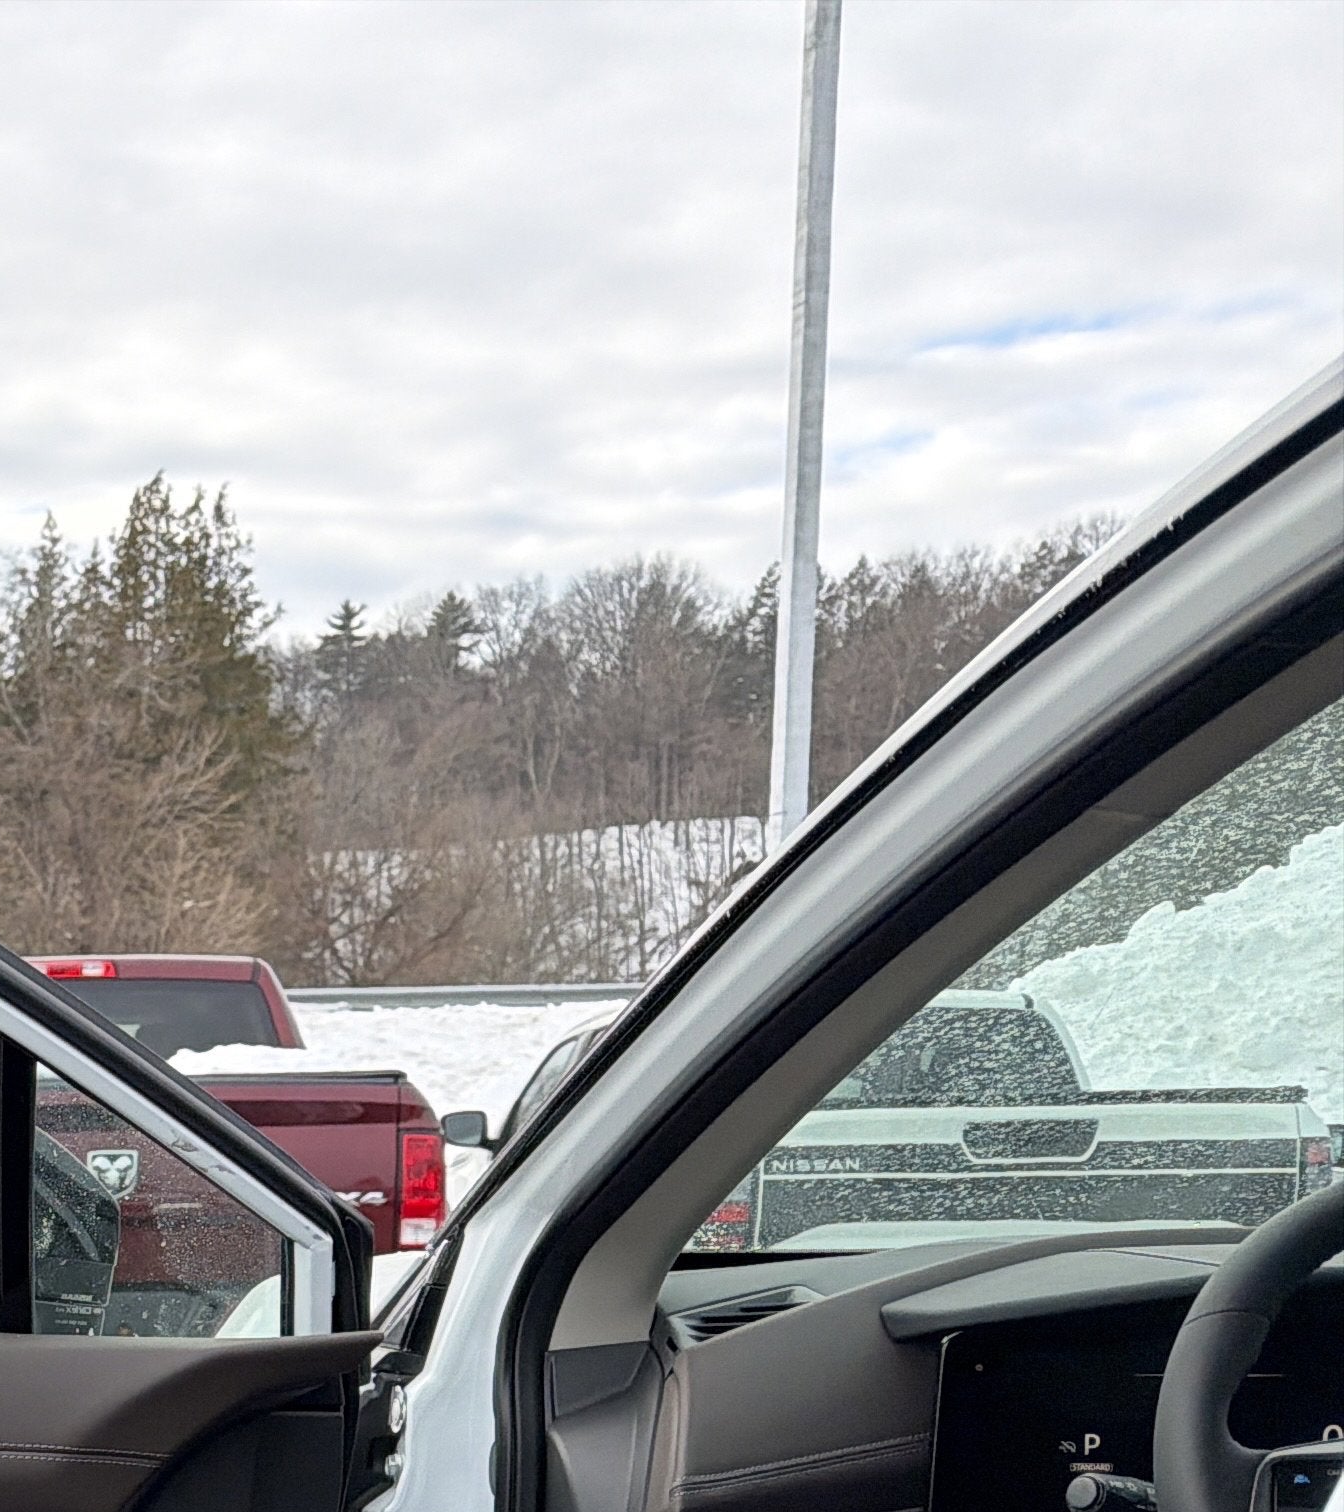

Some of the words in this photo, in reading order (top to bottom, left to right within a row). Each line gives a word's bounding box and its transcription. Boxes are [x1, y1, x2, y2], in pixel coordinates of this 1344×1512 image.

[771, 1157, 860, 1172] NISSAN
[334, 1191, 388, 1207] X4
[1084, 1433, 1101, 1456] P
